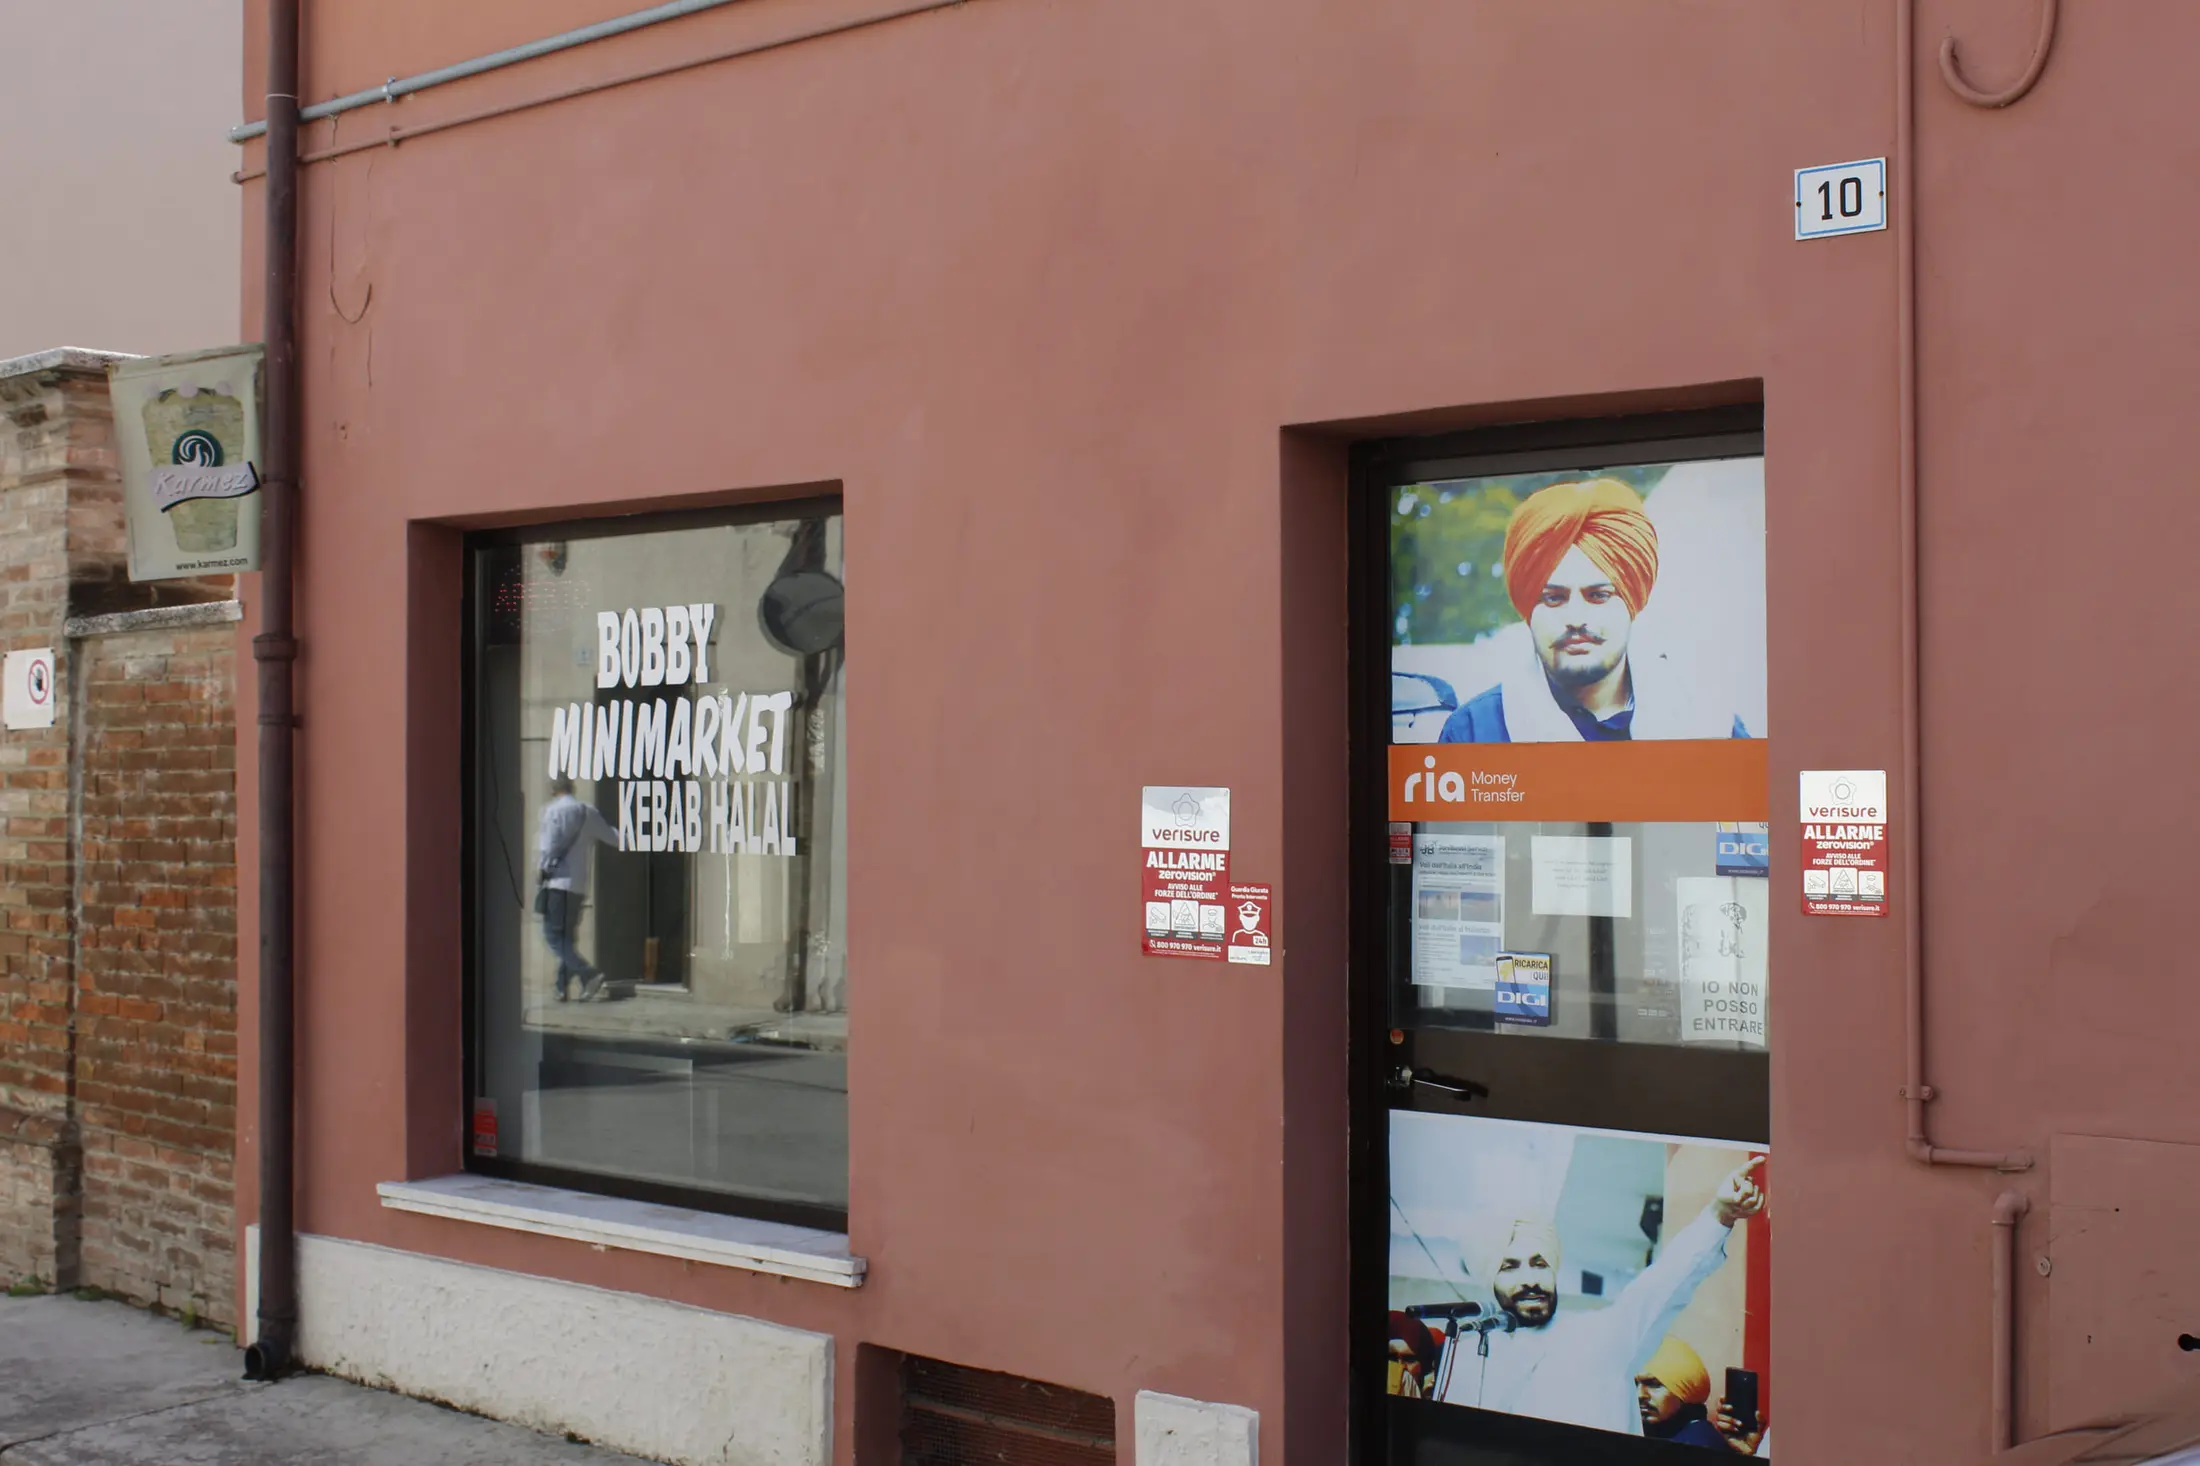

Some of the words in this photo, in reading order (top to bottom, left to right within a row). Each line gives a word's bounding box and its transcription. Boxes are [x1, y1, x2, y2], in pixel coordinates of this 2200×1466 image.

[1818, 177, 1862, 220] 10
[154, 469, 249, 497] Karmez
[175, 556, 249, 571] www.karmez.com
[597, 603, 715, 688] BOBBY
[549, 691, 792, 781] MINIMARKET
[1404, 755, 1465, 803] ria
[1471, 771, 1518, 788] Money
[1471, 788, 1525, 803] Transfer
[618, 781, 702, 852] KEBAB
[710, 781, 796, 856] HALAL
[1809, 807, 1877, 817] verisure
[1152, 828, 1220, 842] verisure
[1804, 825, 1883, 840] ALLARME
[1719, 842, 1768, 856] DIG
[1146, 851, 1225, 871] ALLARME
[1514, 959, 1548, 970] RICARICA
[1702, 981, 1720, 993] IO
[1728, 982, 1759, 996] NON
[1497, 990, 1546, 1006] DIGI
[1703, 999, 1758, 1015] POSSO
[1693, 1017, 1764, 1036] ENTRARE
